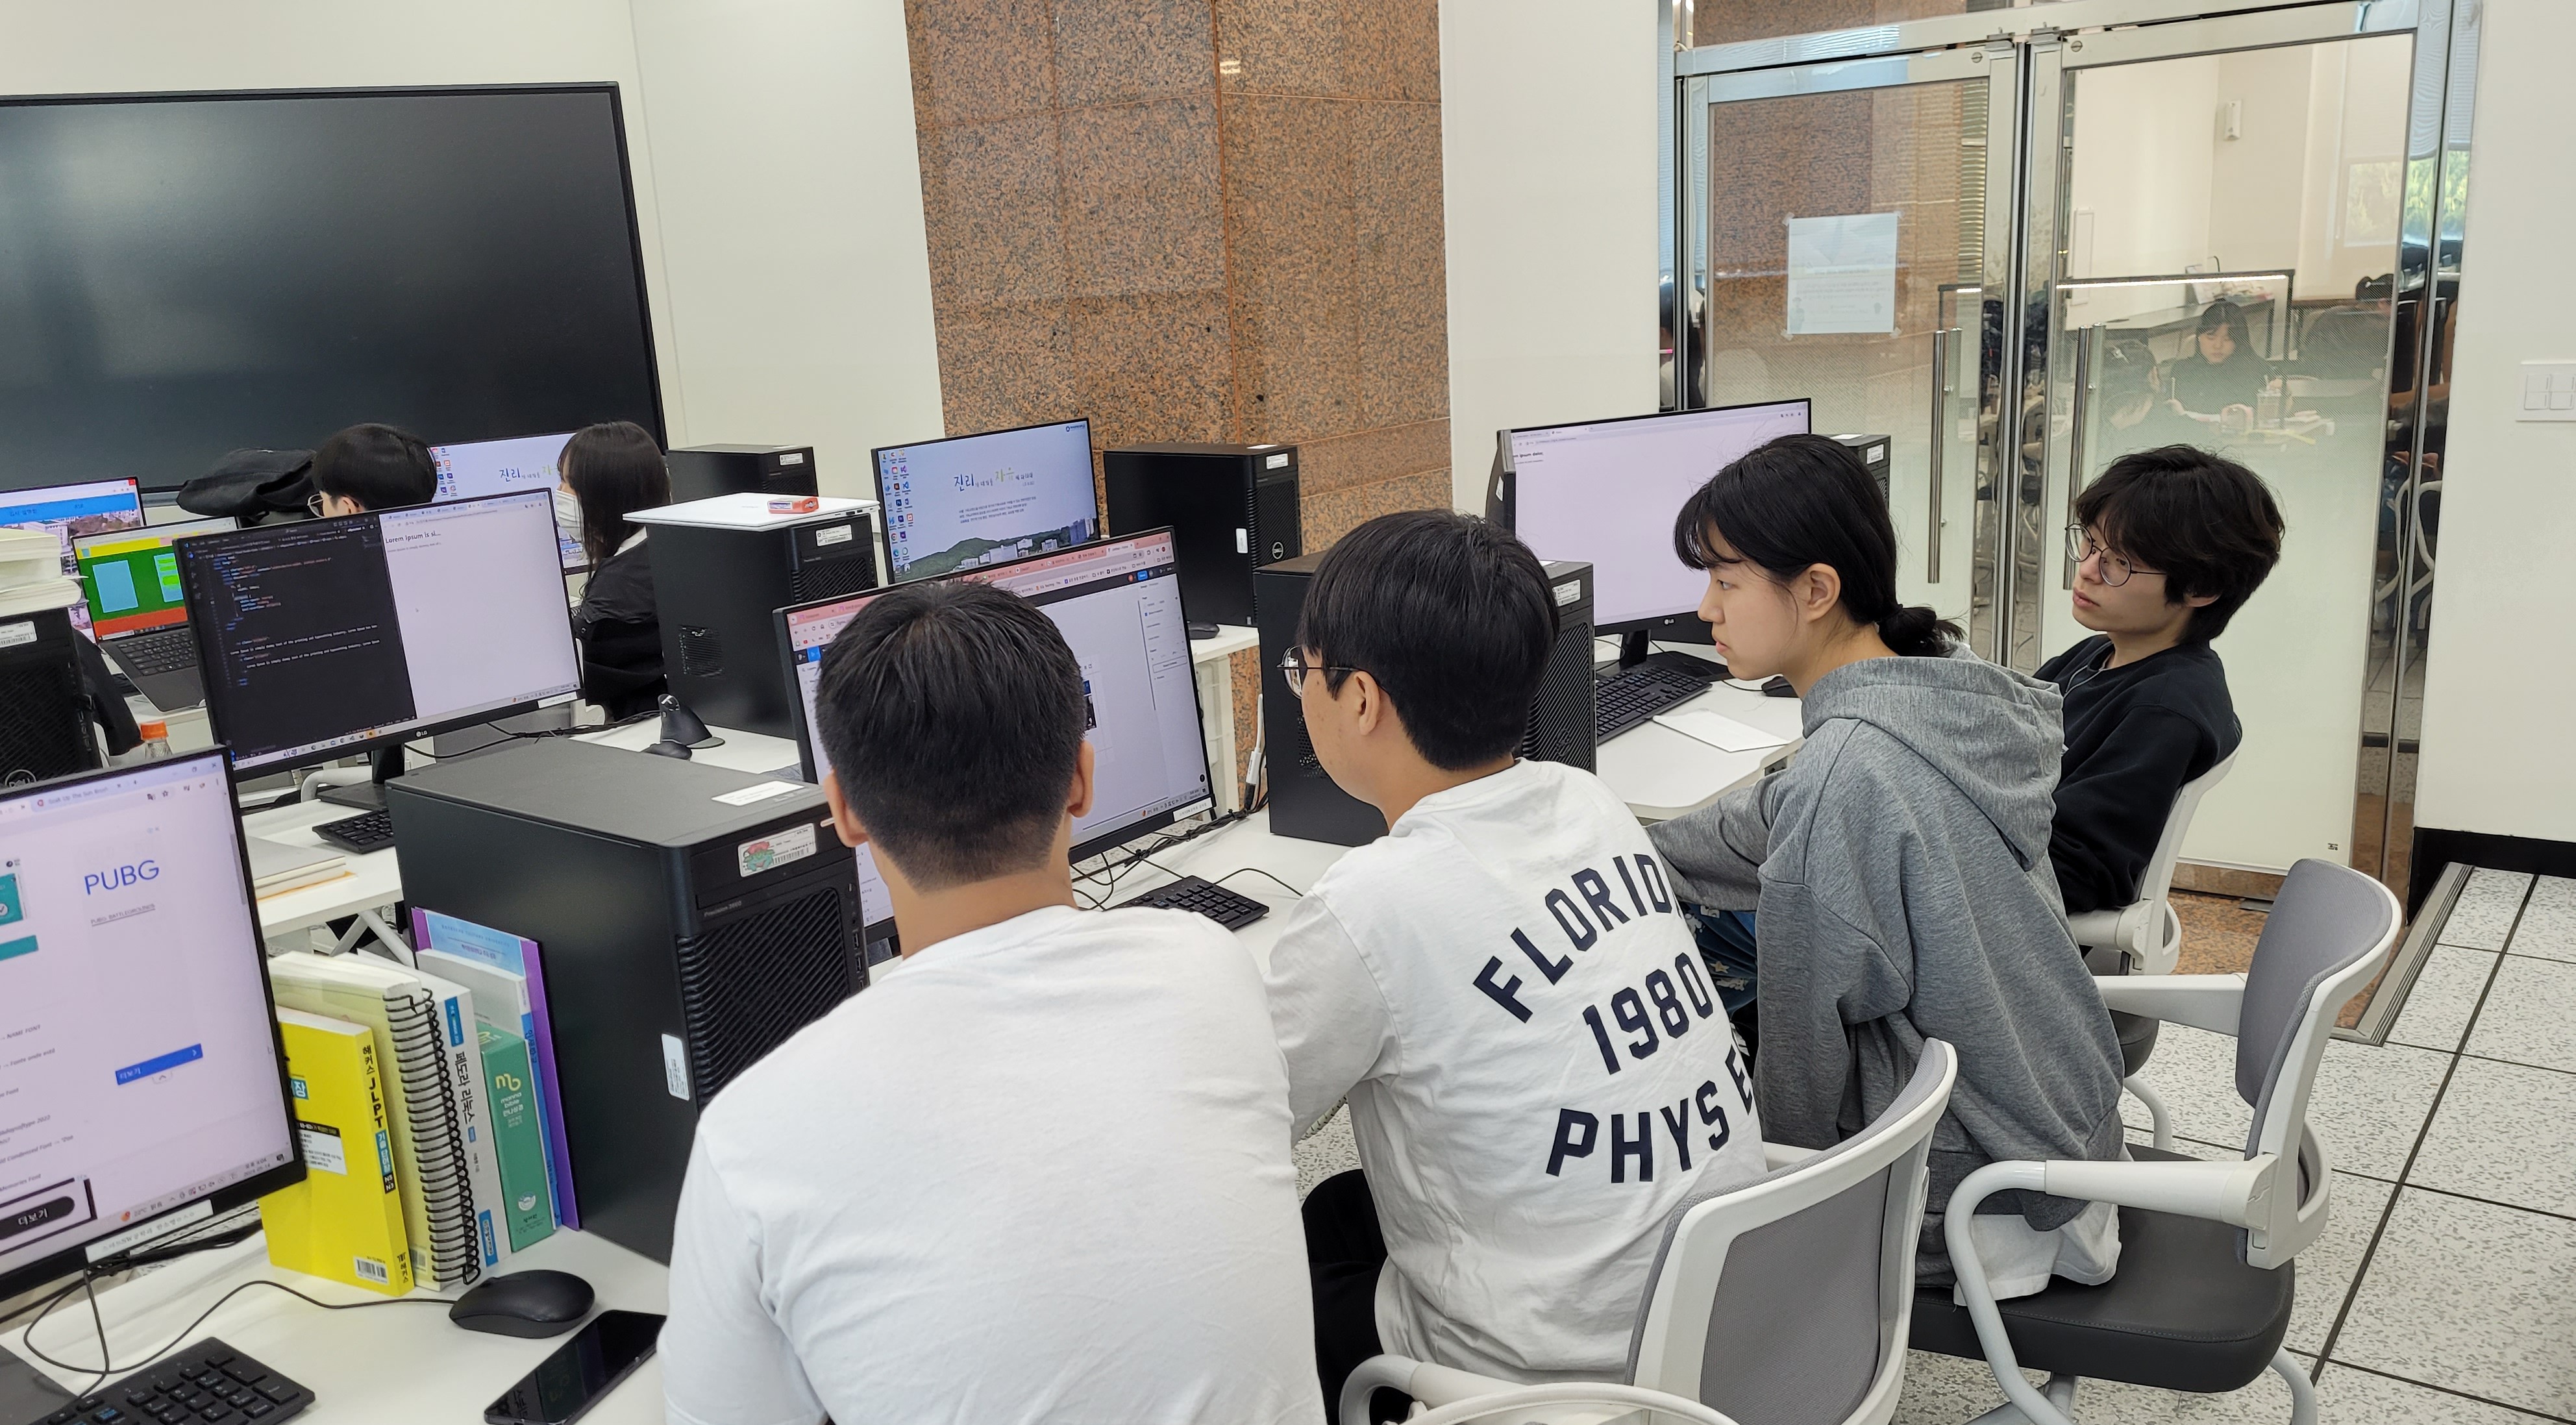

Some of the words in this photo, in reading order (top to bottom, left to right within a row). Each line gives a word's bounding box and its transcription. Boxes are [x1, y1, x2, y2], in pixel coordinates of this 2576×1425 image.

[385, 536, 404, 544] Lorem
[84, 860, 160, 895] PUBG
[91, 915, 106, 924] PUBG
[1472, 853, 1676, 1024] FLORID
[1582, 952, 1714, 1076] 1980
[119, 1067, 141, 1080] 더보기
[362, 1045, 375, 1075] 해커스
[369, 1077, 383, 1128] JLPT
[454, 1051, 471, 1087] 페도라
[460, 1088, 475, 1124] 리눅스
[1545, 1080, 1731, 1183] PHYS
[18, 1208, 48, 1226] 더보기
